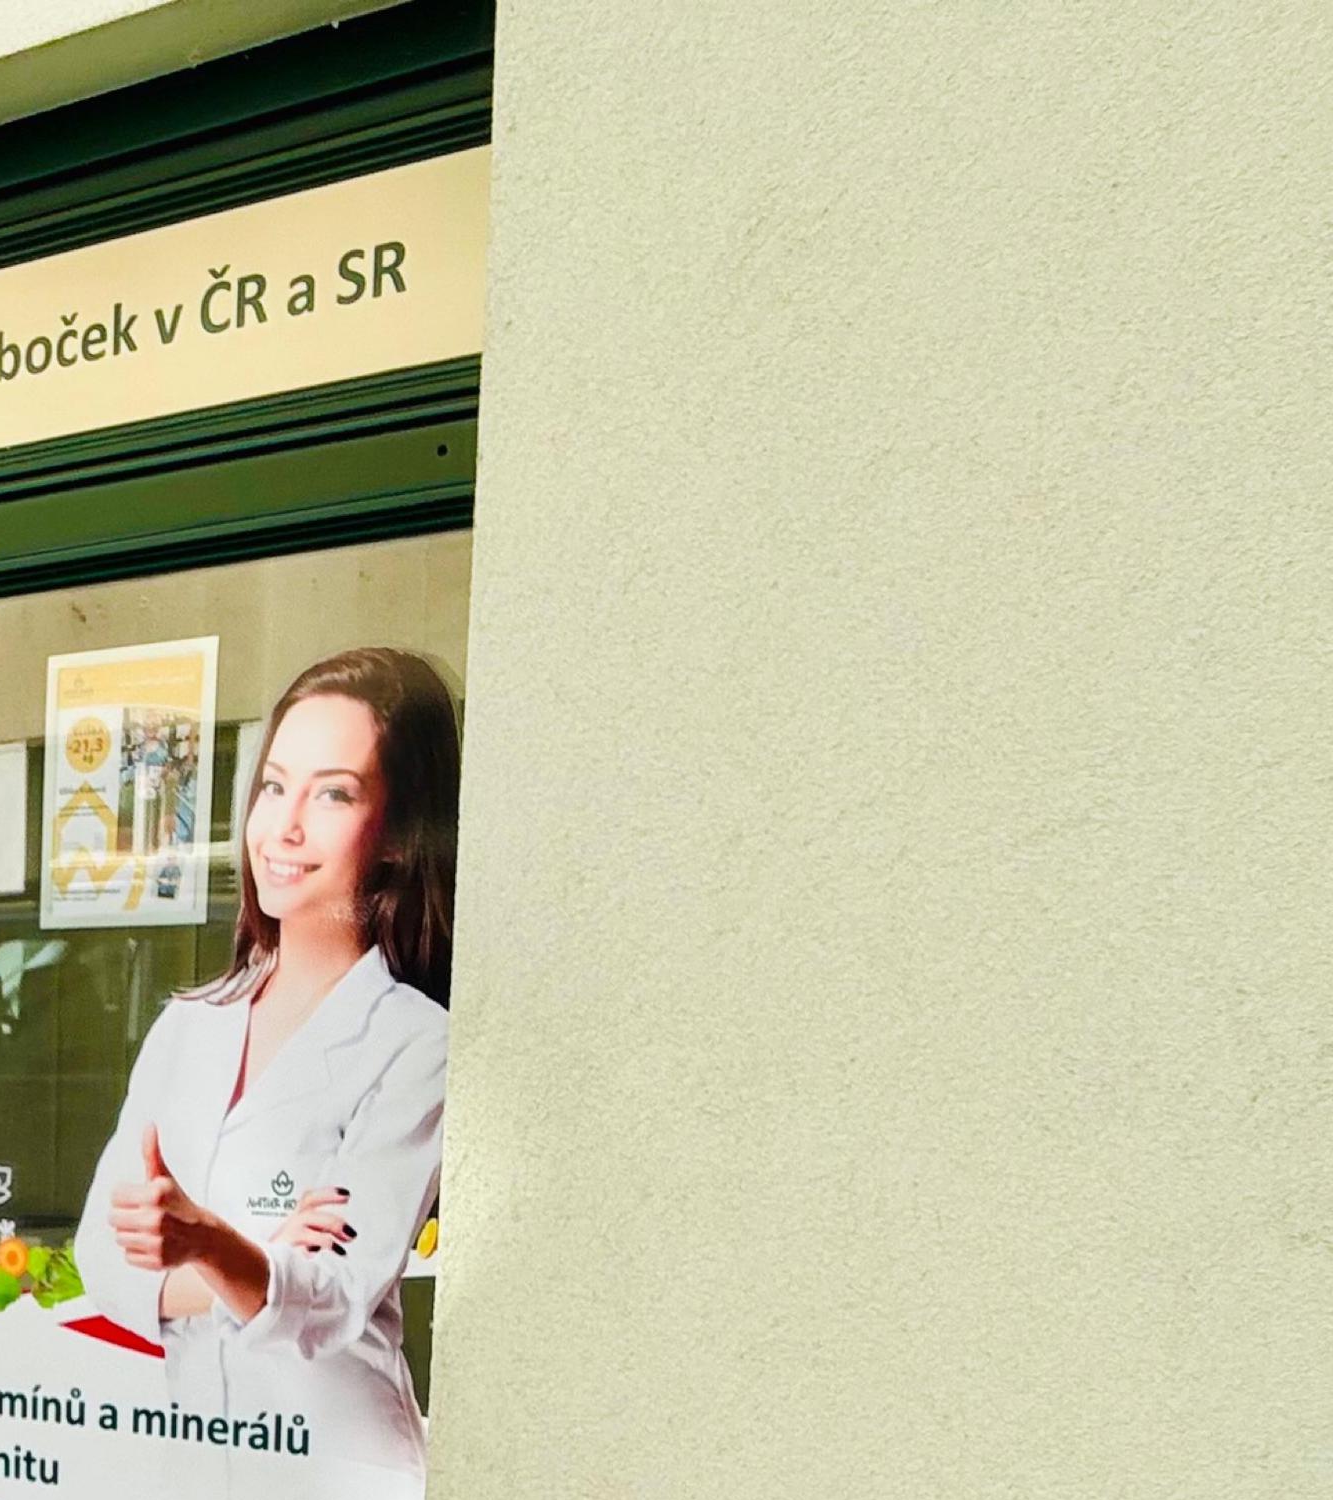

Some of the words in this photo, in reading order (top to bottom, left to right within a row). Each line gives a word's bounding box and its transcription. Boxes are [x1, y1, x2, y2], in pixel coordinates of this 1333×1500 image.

[154, 302, 184, 346] v
[199, 263, 268, 335] ČR
[286, 273, 316, 317] a
[335, 240, 408, 306] SR
[98, 1403, 119, 1430] a
[132, 1401, 311, 1457] minerálů
